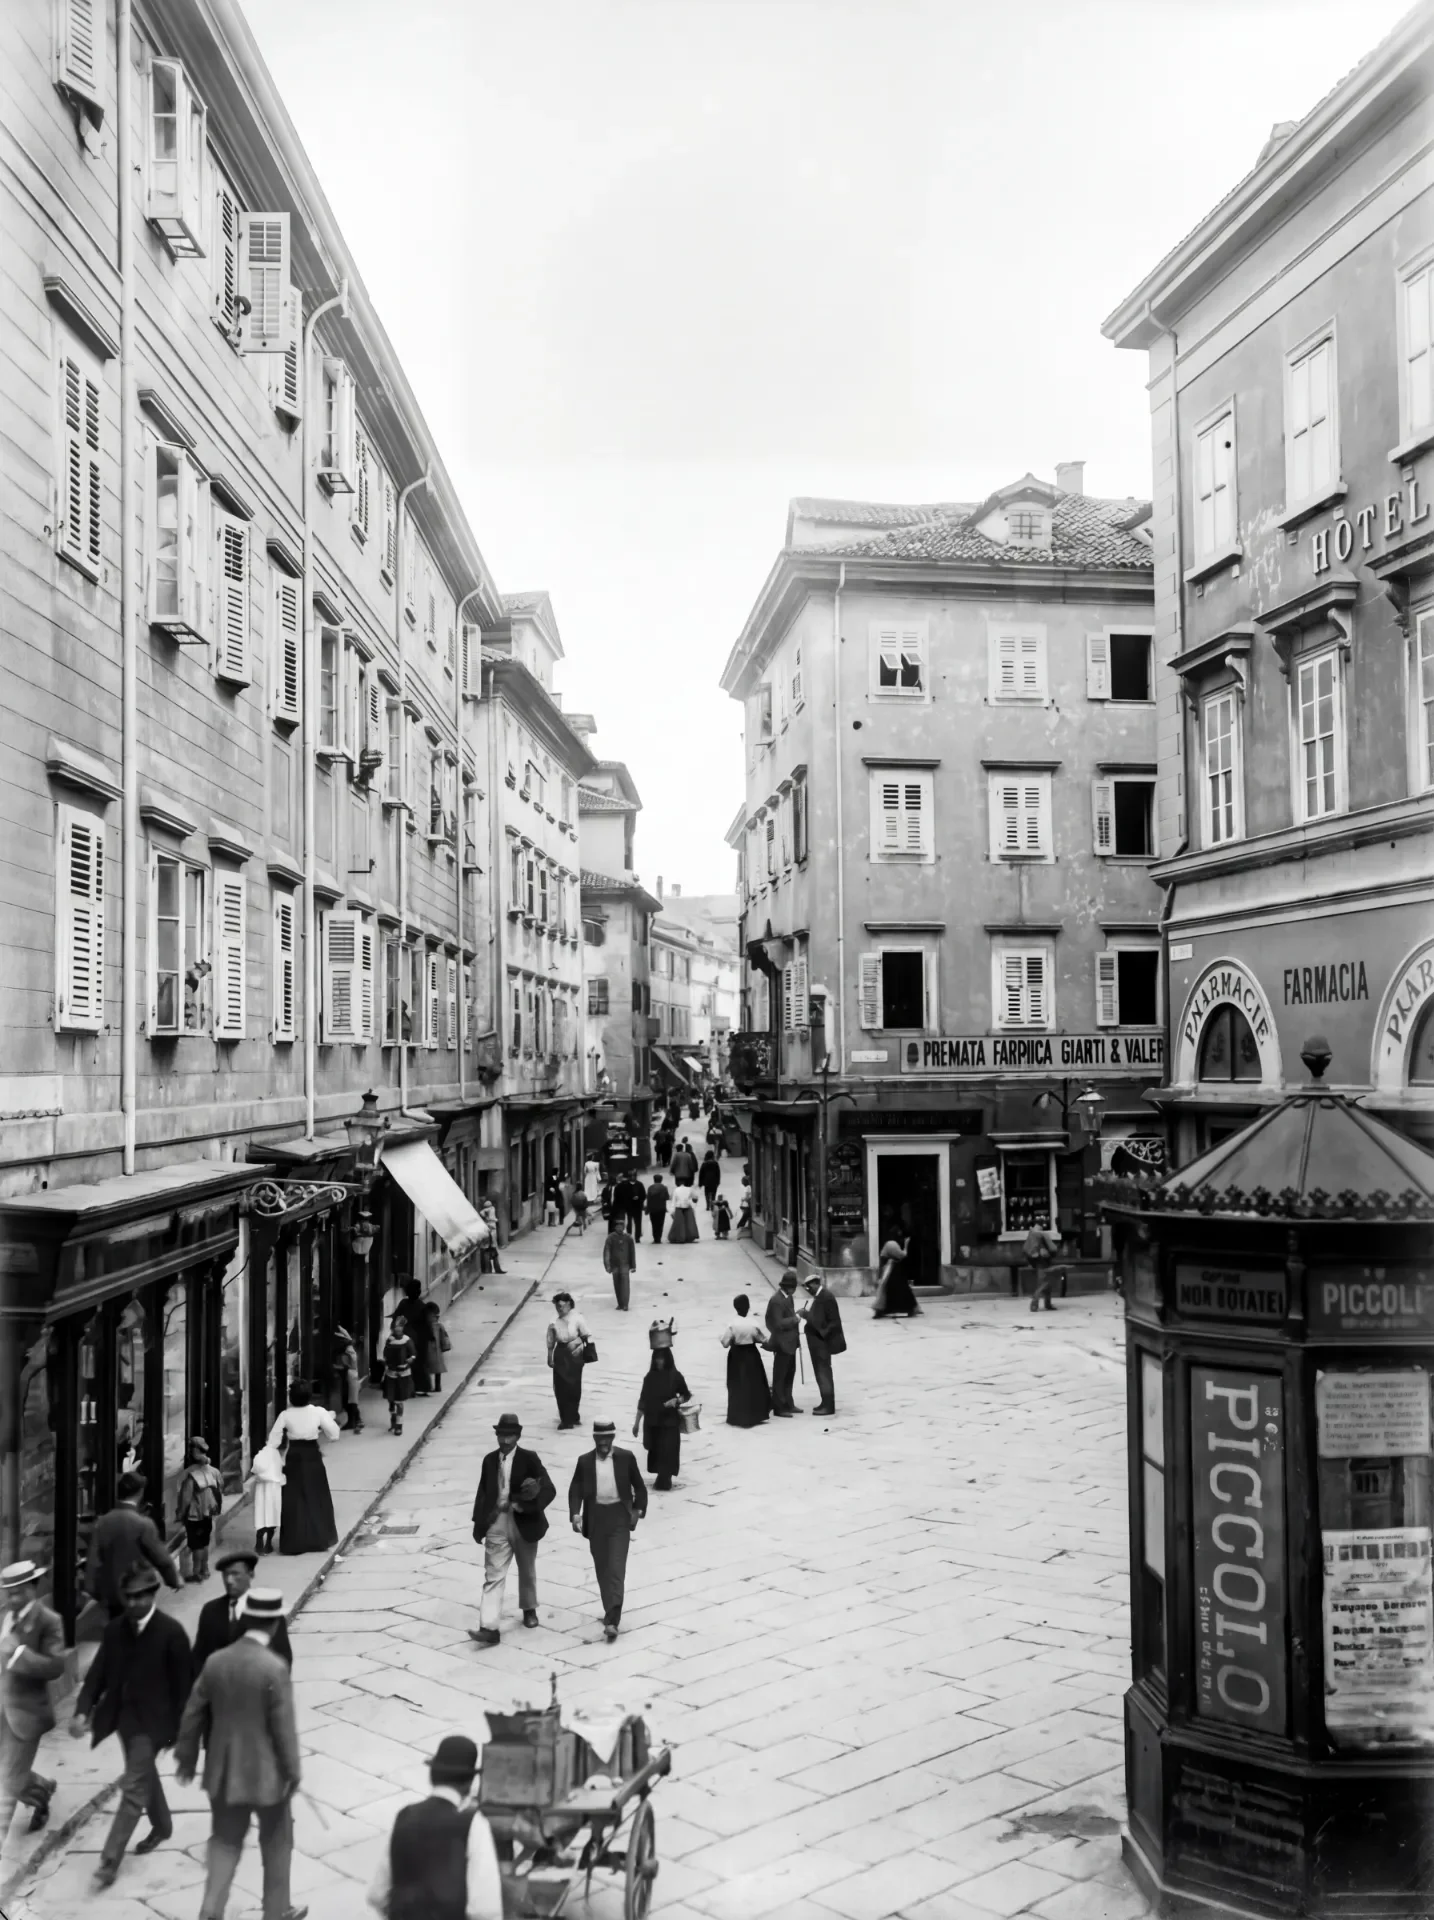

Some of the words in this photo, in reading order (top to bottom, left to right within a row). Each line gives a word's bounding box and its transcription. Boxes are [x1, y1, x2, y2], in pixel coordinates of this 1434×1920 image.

[1284, 961, 1369, 1005] FARMACIA
[923, 1040, 986, 1066] PREMATA
[1061, 1038, 1106, 1064] GIARTI
[1110, 1038, 1121, 1064] &
[1205, 1380, 1270, 1715] PICCOLO
